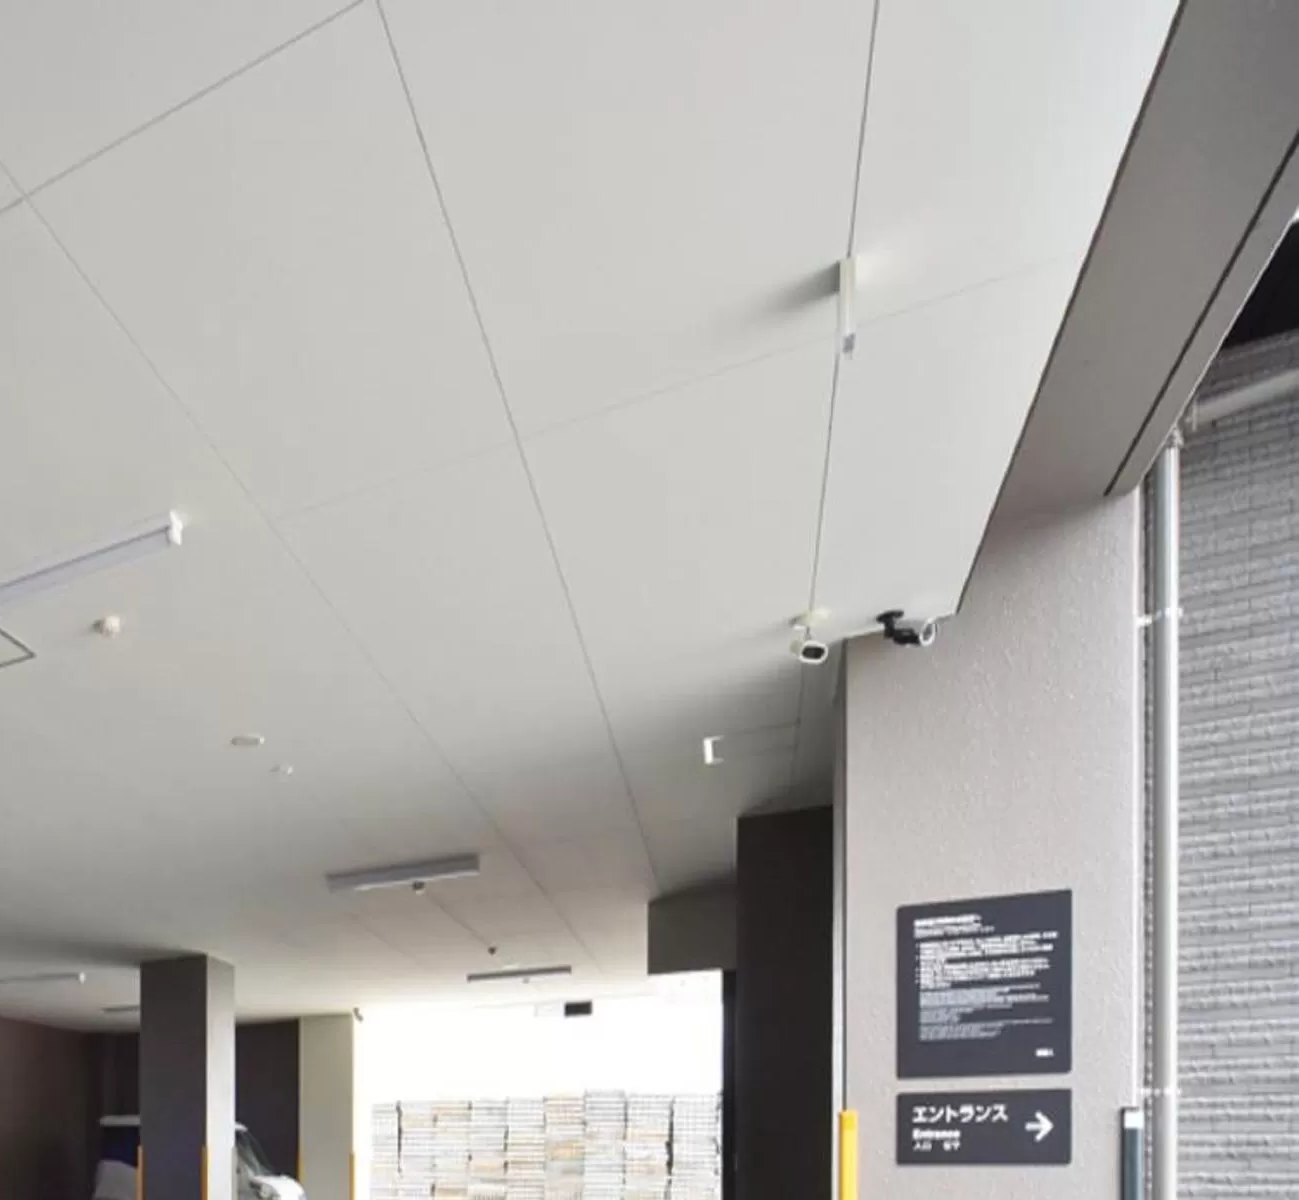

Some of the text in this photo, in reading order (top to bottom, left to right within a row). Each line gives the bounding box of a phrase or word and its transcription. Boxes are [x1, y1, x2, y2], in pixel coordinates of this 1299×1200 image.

[912, 1103, 1009, 1123] エントランス
